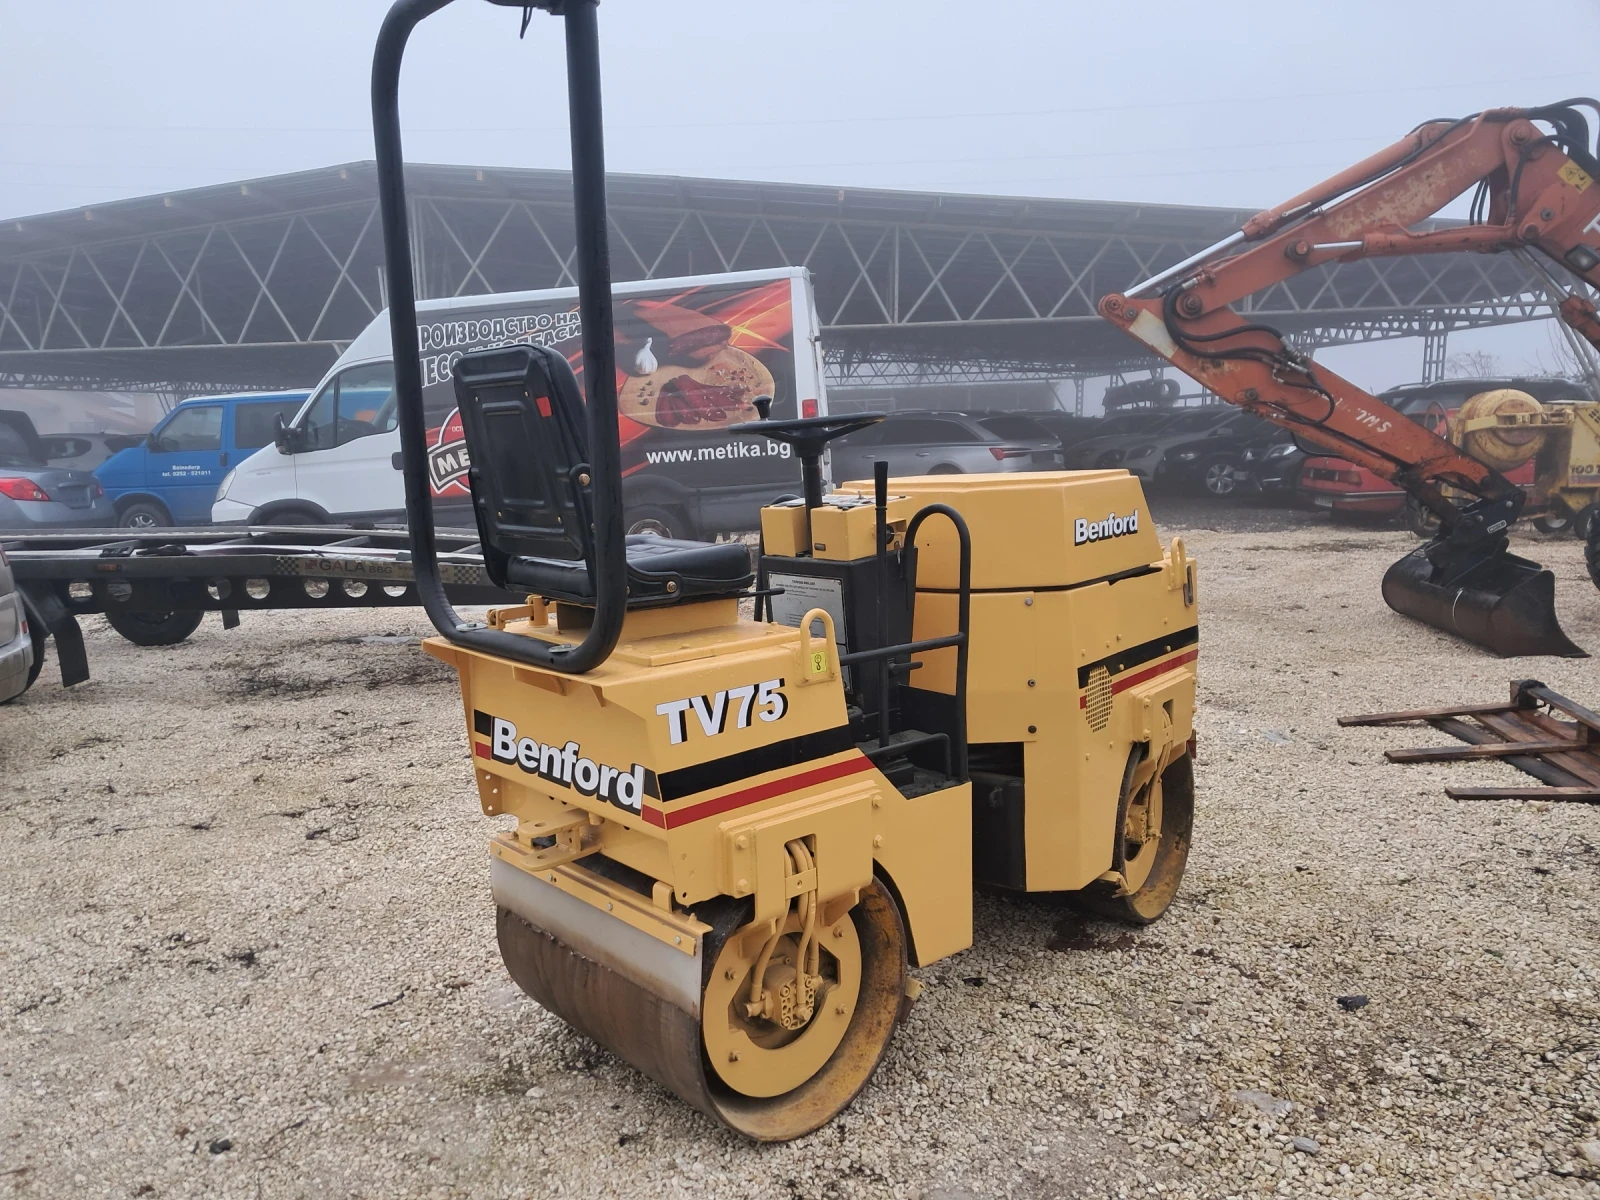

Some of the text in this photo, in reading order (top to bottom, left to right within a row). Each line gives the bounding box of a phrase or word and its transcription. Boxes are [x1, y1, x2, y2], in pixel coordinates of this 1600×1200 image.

[417, 312, 580, 352] РОИЗВОДСТВО НА
[488, 322, 582, 350] БАСИ
[646, 440, 791, 464] www.metika.bg
[1074, 509, 1138, 546] Benford
[319, 559, 366, 573] GALA
[656, 678, 789, 746] TV75
[491, 715, 645, 816] Benford
